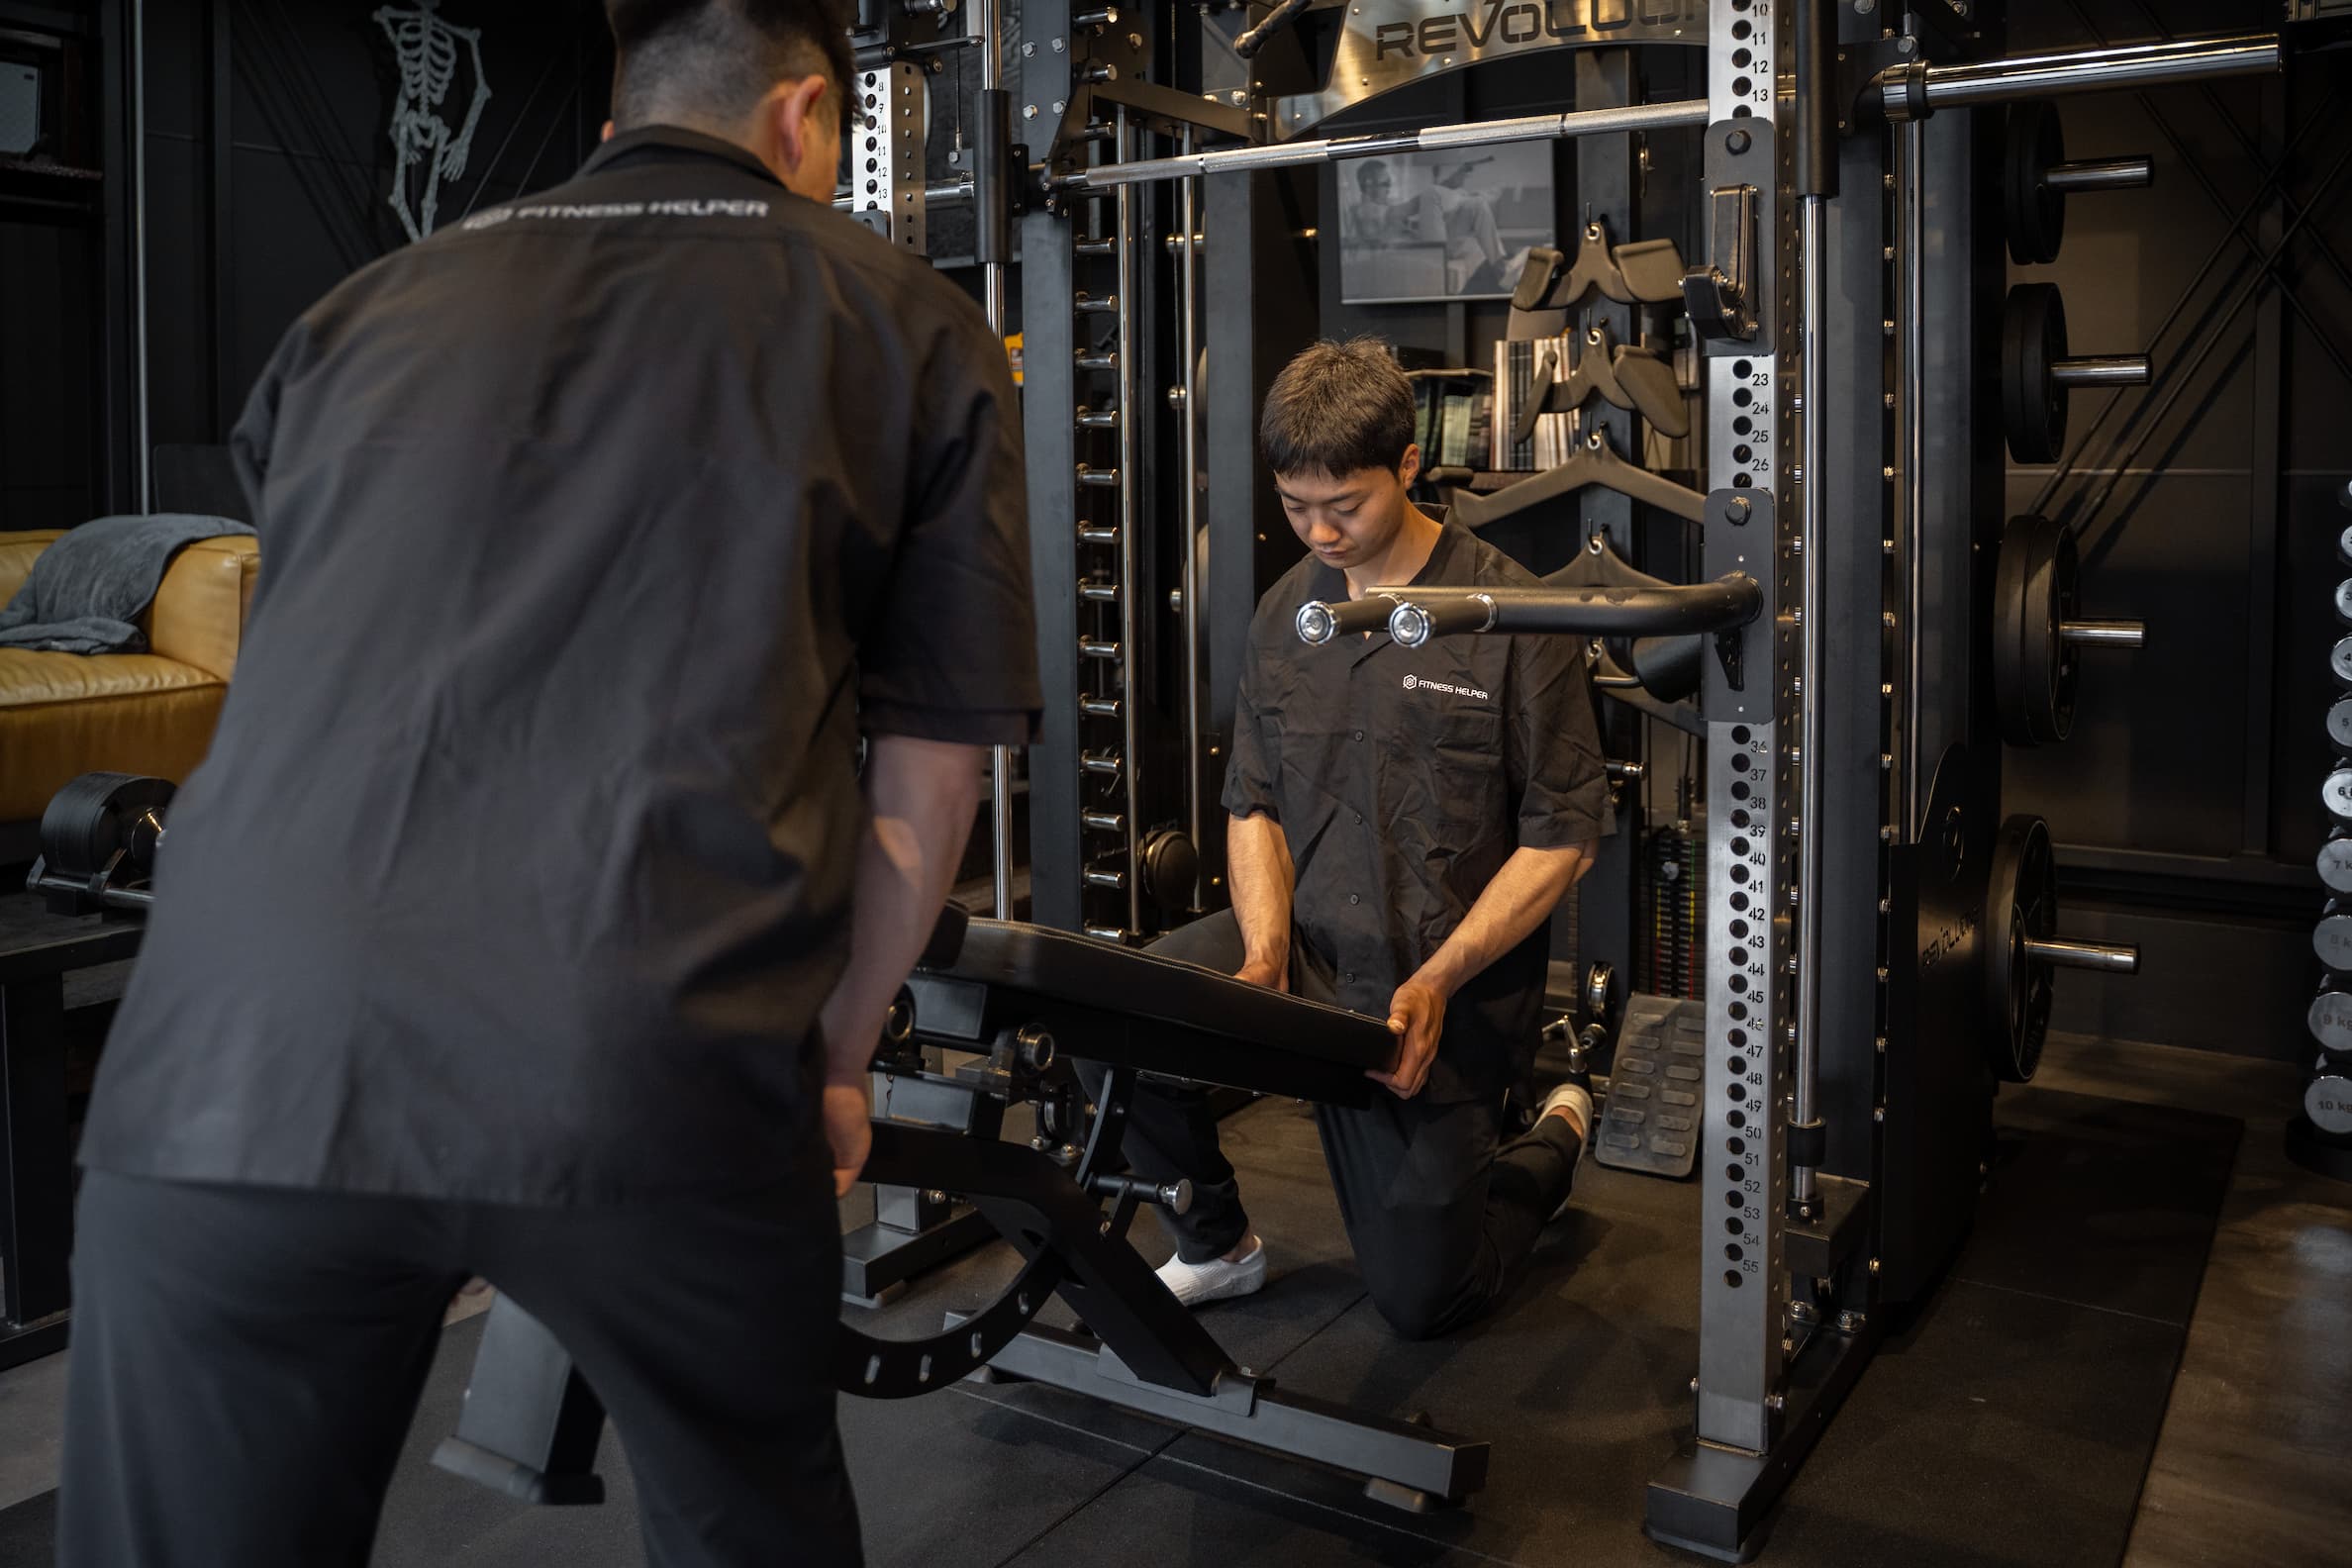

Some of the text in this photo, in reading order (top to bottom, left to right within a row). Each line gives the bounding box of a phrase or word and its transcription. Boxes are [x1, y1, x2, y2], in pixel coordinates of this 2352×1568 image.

[1753, 4, 1768, 17] 10
[1753, 32, 1766, 46] 11
[1753, 60, 1768, 73] 12
[879, 82, 884, 91] 8
[1753, 89, 1768, 102] 13
[878, 147, 886, 156] 11
[878, 167, 887, 177] 12
[878, 189, 887, 198] 13
[518, 199, 769, 219] FITNESS HELPER
[1752, 373, 1769, 386] 23
[1752, 402, 1769, 415] 24
[1752, 430, 1769, 442] 25
[1752, 458, 1769, 471] 26
[1419, 680, 1489, 700] FITNESS HELPER
[1750, 740, 1767, 752] 36
[1750, 769, 1767, 781] 37
[1750, 797, 1766, 810] 38
[1750, 825, 1766, 837] 39
[1749, 852, 1766, 866] 40
[1748, 879, 1763, 893] 41
[1748, 908, 1765, 921] 42
[1748, 934, 1765, 948] 43
[1748, 962, 1765, 976] 44
[1747, 990, 1764, 1004] 45
[1747, 1018, 1764, 1030] 46
[2323, 1014, 2331, 1025] 9
[1746, 1045, 1763, 1058] 47
[1746, 1072, 1762, 1085] 48
[1745, 1099, 1762, 1113] 49
[2318, 1101, 2333, 1110] 10
[1745, 1127, 1761, 1139] 50
[1744, 1152, 1759, 1166] 51
[1744, 1180, 1760, 1193] 52
[1743, 1207, 1760, 1220] 53
[1743, 1233, 1759, 1246] 54
[1743, 1259, 1759, 1273] 55
